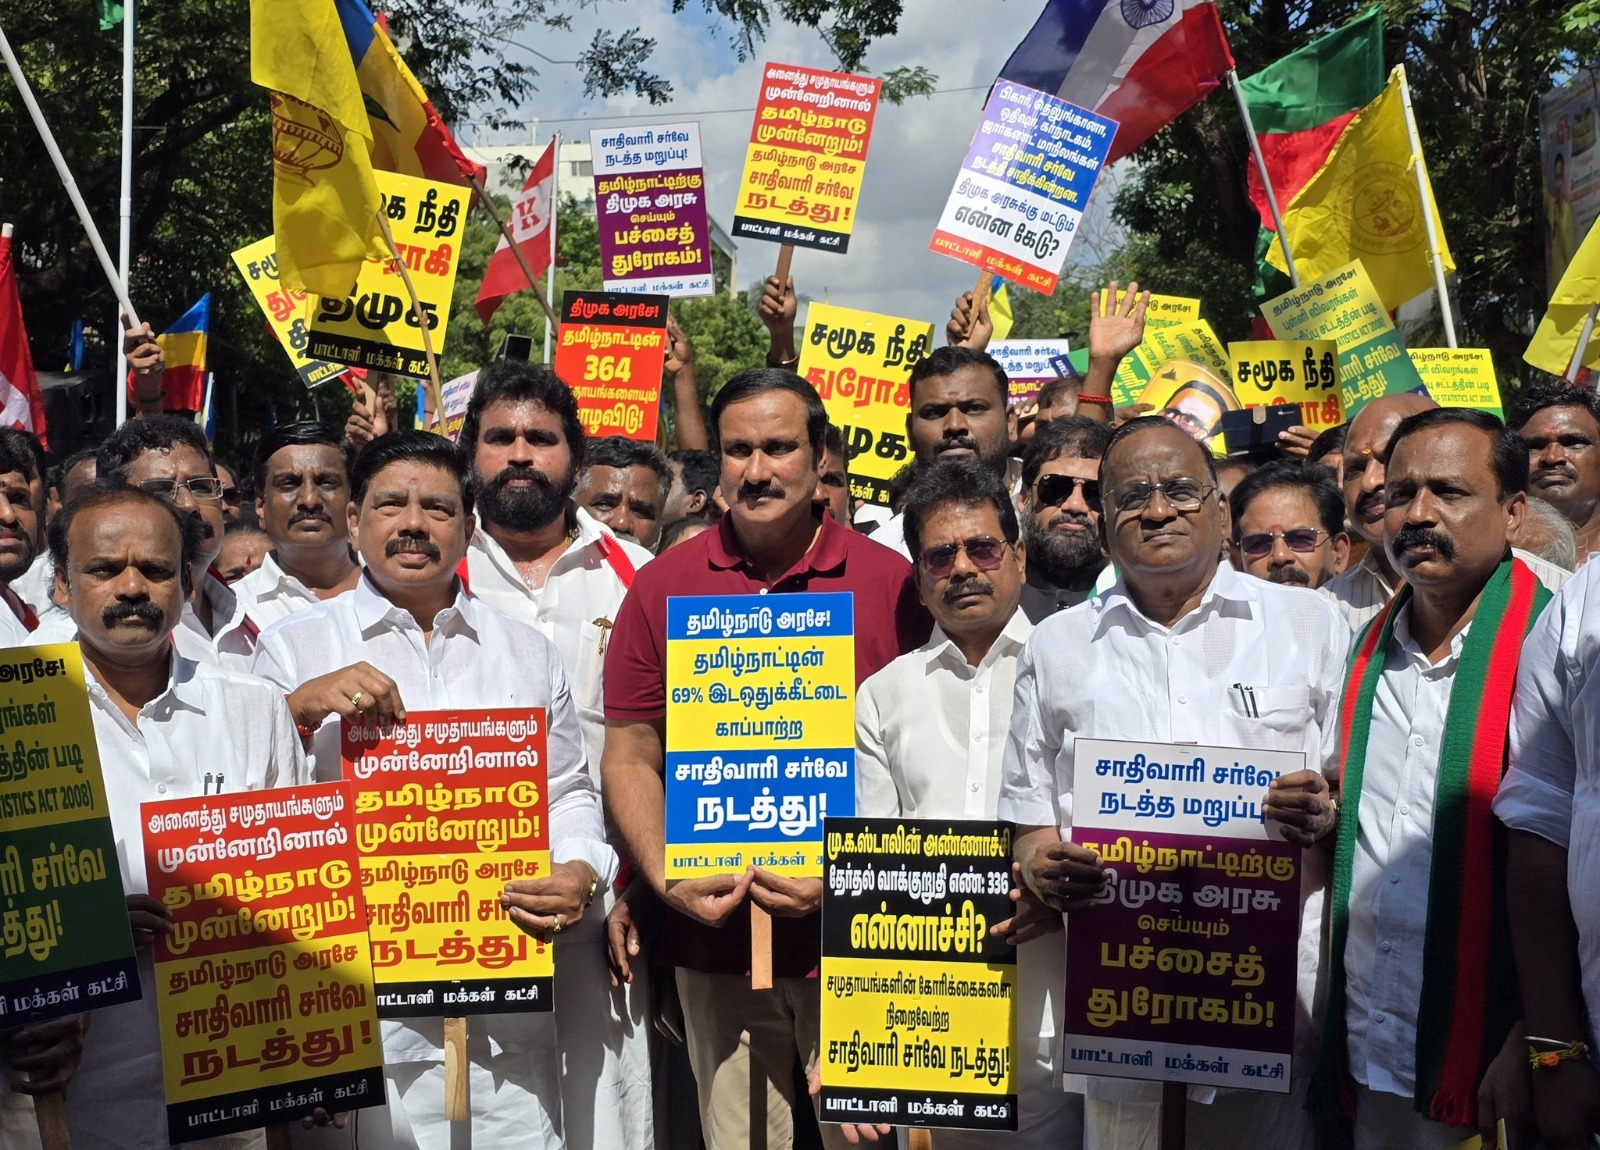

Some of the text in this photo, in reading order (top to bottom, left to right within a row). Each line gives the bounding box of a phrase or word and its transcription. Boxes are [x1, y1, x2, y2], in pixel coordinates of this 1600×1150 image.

[766, 68, 875, 96] அனைத்து சமுதாயங்களும்
[765, 85, 871, 112] முன்னேறினால்
[999, 86, 1107, 138] பிகார், தெலுங்கானா,
[761, 105, 867, 135] தமிழ்நாடு
[601, 131, 689, 150] சாதிவாரி சர்வே
[757, 124, 863, 156] முன்னேறும்!
[1040, 122, 1093, 152] கர்நாடகம்,
[605, 147, 688, 167] நடத்த மறுப்பு!
[751, 149, 857, 175] தமிழ்நாடு அரசே
[991, 140, 1075, 182] சாதிவாரி சர்வே
[1036, 136, 1100, 171] மாநிலங்கள்
[598, 172, 702, 195] தமிழ்நாட்டிற்கு
[749, 168, 854, 200] சாதிவாரி சர்வே
[971, 156, 1078, 203] நடத்தி சாதிக்கின்றன.
[413, 188, 460, 239] நீதி
[605, 192, 698, 214] திமுக அரசு
[630, 210, 676, 223] செய்யும்
[744, 192, 851, 224] நடத்து!
[957, 177, 1075, 233] திமுக அரசுக்கு மட்டும்
[614, 222, 695, 245] பச்சைத்
[741, 222, 840, 246] பாட்டாளி மக்கள் கட்சி
[954, 205, 1060, 260] என்ன கேடு?
[611, 245, 702, 276] துரோகம்!
[934, 237, 1052, 287] பாட்டாளி மக்கள் கட்சி
[569, 297, 659, 320] திமுக அரசே!
[1272, 269, 1358, 318] தமிழ்நாடு அரசே!
[1282, 287, 1360, 332] புள்ளி விவரங்கள்
[1320, 301, 1378, 335] சட்டத்தின் படி
[562, 325, 661, 350] தமிழ்நாட்டின்
[810, 322, 876, 360] சமூக
[989, 345, 1060, 358] சாதிவாரி சர்வே
[313, 340, 404, 371] பாட்டாளி மக்கள்
[583, 354, 632, 382] 364
[1237, 358, 1295, 392] சமூக
[1302, 346, 1335, 391] நீதி
[1363, 342, 1401, 370] சர்வே
[686, 606, 831, 637] தமிழ்நாடு அரசே!
[693, 645, 824, 677] தமிழ்நாட்டின்
[671, 677, 848, 710] 69% இடஒதுக்கீட்டை
[424, 715, 538, 747] சமுதாயங்களும்
[715, 716, 803, 741] காப்பாற்ற
[53, 743, 84, 774] படி
[353, 744, 539, 779] முன்னேறினால்
[674, 755, 848, 786] சாதிவாரி சர்வே
[1095, 753, 1206, 785] சாதிவாரி
[37, 780, 95, 814] ACT 2008)
[148, 789, 345, 835] அனைத்து சமுதாயங்களும்
[355, 780, 540, 815] தமிழ்நாடு
[693, 787, 828, 836] நடத்து!
[1098, 788, 1176, 819] நடத்த
[355, 809, 541, 853] முன்னேறும்!
[827, 824, 1011, 861] மு.க.ஸ்டாலின் அண்ணாச்சி
[157, 822, 349, 874] முன்னேறினால்
[672, 852, 742, 868] பாட்டாளி
[752, 851, 806, 867] மக்கள்
[31, 841, 107, 891] சர்வே
[360, 858, 540, 889] தமிழ்நாடு அரசே
[161, 859, 353, 911] தமிழ்நாடு
[829, 862, 1009, 905] தேர்தல் வாக்குறுதி எண்: 336
[1192, 884, 1281, 915] அரசு
[164, 892, 357, 955] முன்னேறும்!
[365, 889, 470, 934] சாதிவாரி
[850, 899, 987, 954] என்னாச்சி?
[1137, 913, 1230, 937] செய்யும்
[168, 944, 359, 996] தமிழ்நாடு அரசே
[1100, 937, 1266, 987] பச்சைத்
[13, 980, 80, 1012] மக்கள்
[87, 970, 129, 997] கட்சி
[443, 985, 539, 1004] மக்கள் கட்சி
[827, 970, 1012, 999] சமுதாயங்களின் கோரிக்கைகளை
[175, 980, 368, 1043] சாதிவாரி சர்வே
[885, 1002, 950, 1033] நிறைவேற்ற
[1086, 985, 1275, 1029] துரோகம்!
[180, 1019, 373, 1087] நடத்து!
[828, 1030, 1010, 1087] சாதிவாரி சர்வே நடத்து!
[1070, 1047, 1285, 1081] பாட்டாளி மக்கள் கட்சி
[187, 1078, 369, 1128] பாட்டாளி மக்கள் கட்சி
[825, 1096, 1011, 1119] பாட்டாளி மக்கள் கட்சி
